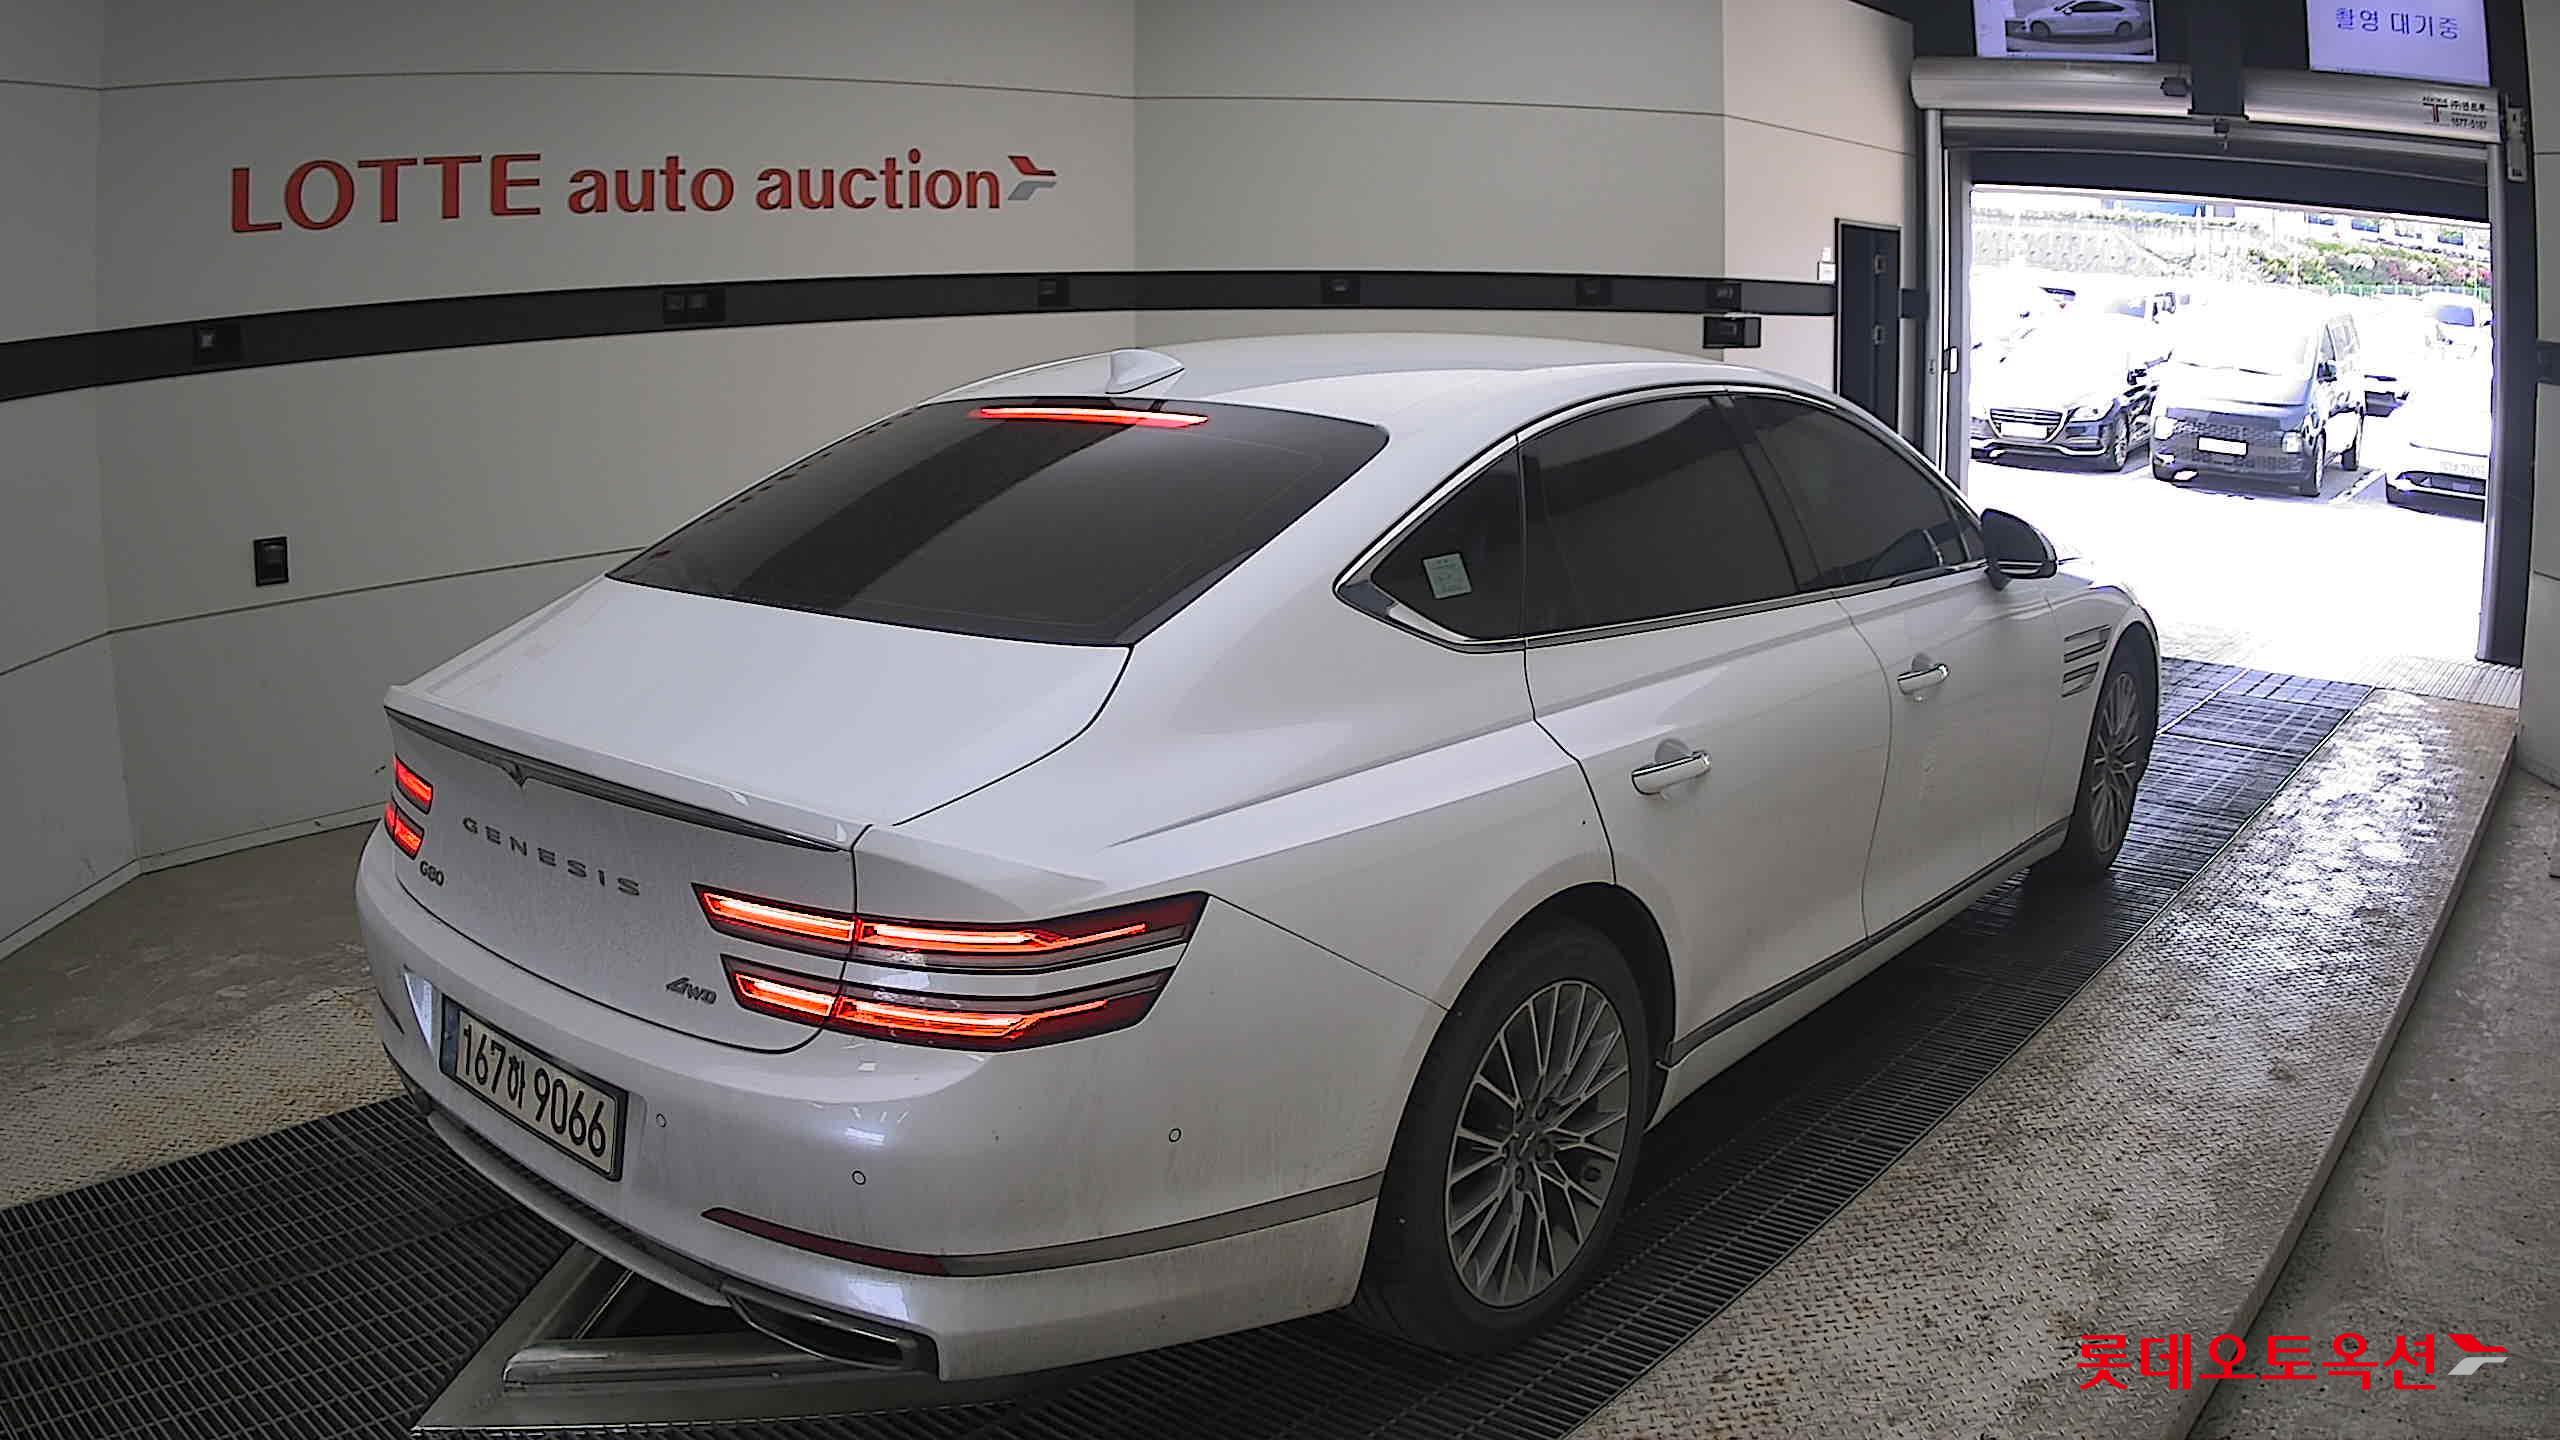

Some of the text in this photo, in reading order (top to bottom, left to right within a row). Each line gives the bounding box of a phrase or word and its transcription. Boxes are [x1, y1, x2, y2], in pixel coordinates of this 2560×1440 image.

[2336, 7, 2459, 40] 촬영 대기중
[232, 148, 1001, 233] LOTTE auto auction
[420, 860, 445, 887] G80
[462, 816, 641, 897] GENESIS
[463, 1024, 606, 1157] 167하 9066
